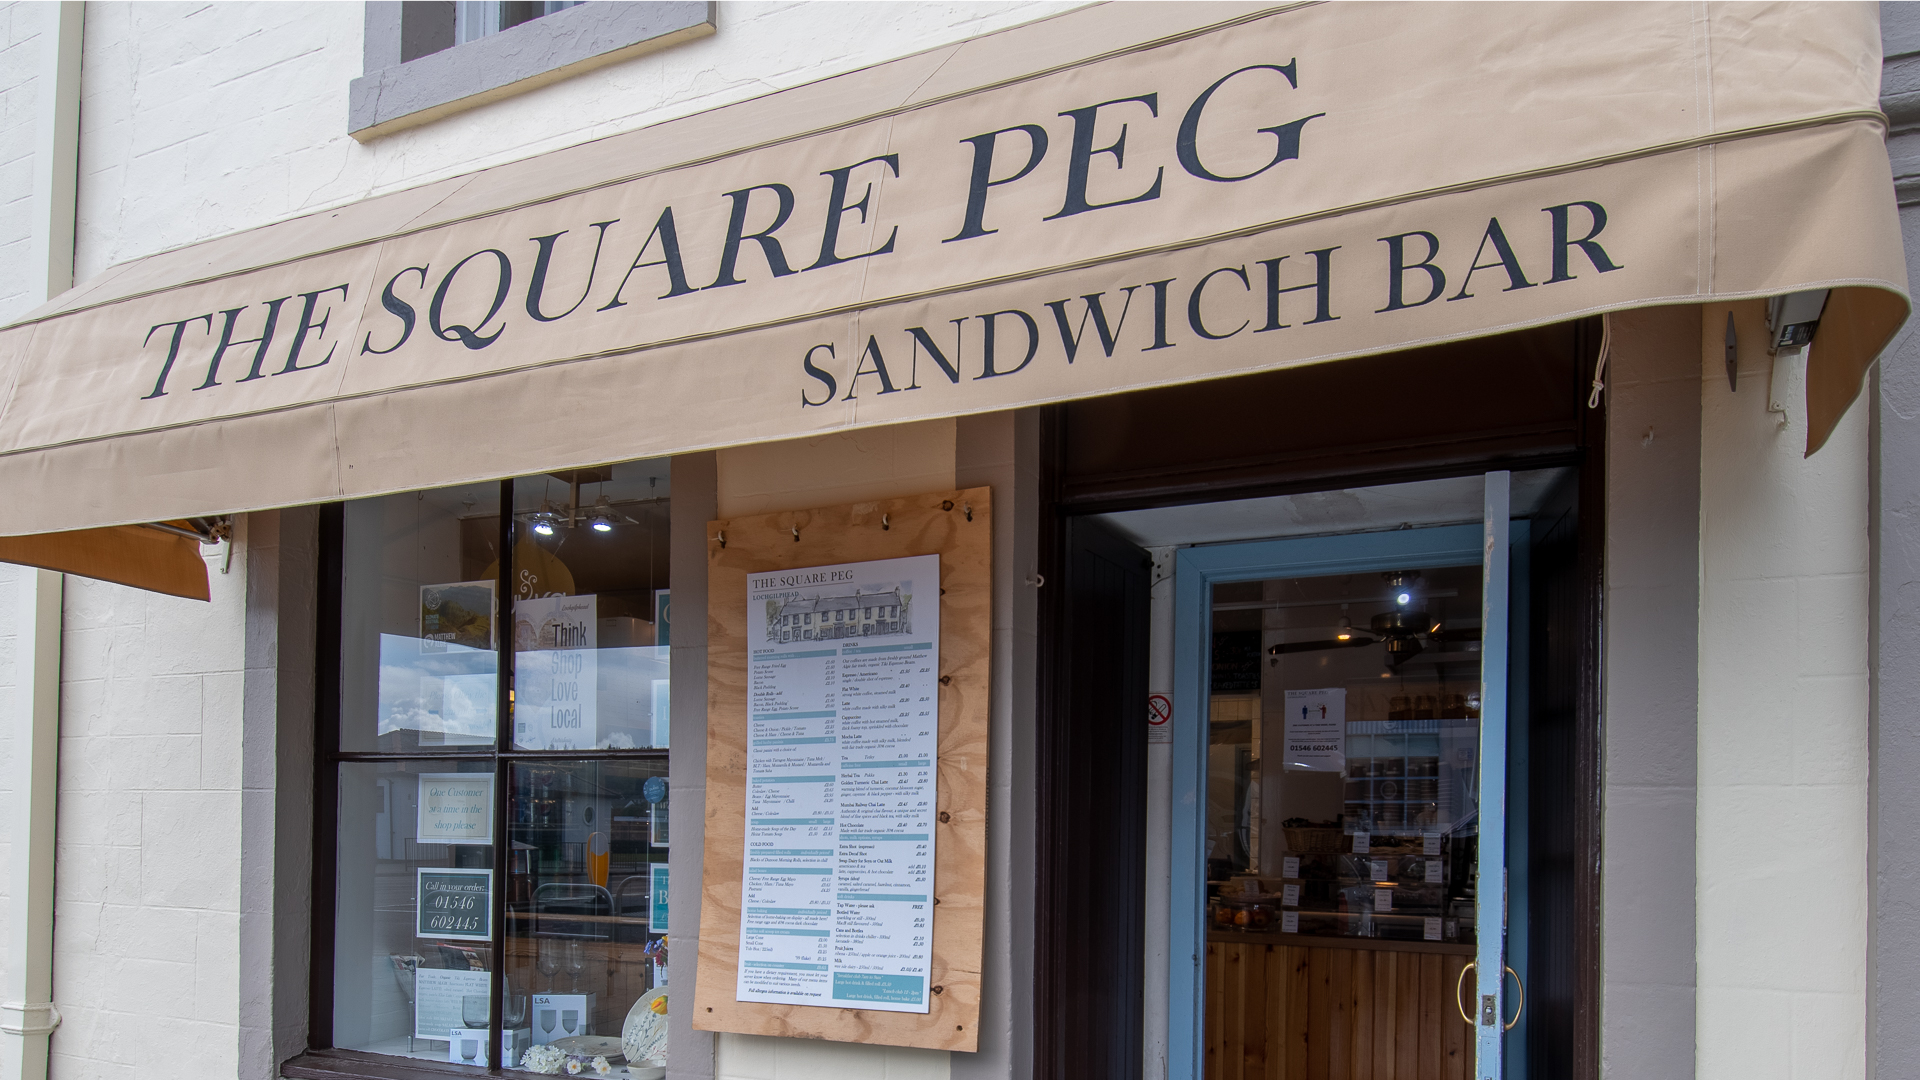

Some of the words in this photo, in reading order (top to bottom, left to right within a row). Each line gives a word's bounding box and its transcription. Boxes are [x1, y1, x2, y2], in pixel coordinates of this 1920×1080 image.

[141, 283, 349, 400] THE
[361, 153, 900, 356] SQUARE
[942, 57, 1326, 244] PEG
[801, 245, 1342, 409] SANDWICH
[1375, 200, 1624, 315] BAR
[753, 577, 776, 589] THE
[780, 572, 827, 586] SQUARE
[831, 570, 854, 581] PEG
[753, 591, 800, 600] LOCHGILPHEAD
[434, 632, 456, 642] MATTHEW
[552, 621, 587, 647] Think
[552, 649, 582, 679] Shop
[551, 678, 578, 701] Love
[551, 703, 582, 729] Local
[430, 787, 446, 796] One
[448, 787, 483, 796] Customer
[443, 804, 460, 813] time
[461, 804, 469, 813] in
[470, 804, 482, 813] the
[434, 820, 452, 831] shop
[452, 820, 476, 831] please
[426, 882, 440, 890] Call
[440, 882, 446, 890] in
[464, 882, 485, 891] order:
[435, 895, 476, 910] 01546
[430, 915, 479, 930] 602445
